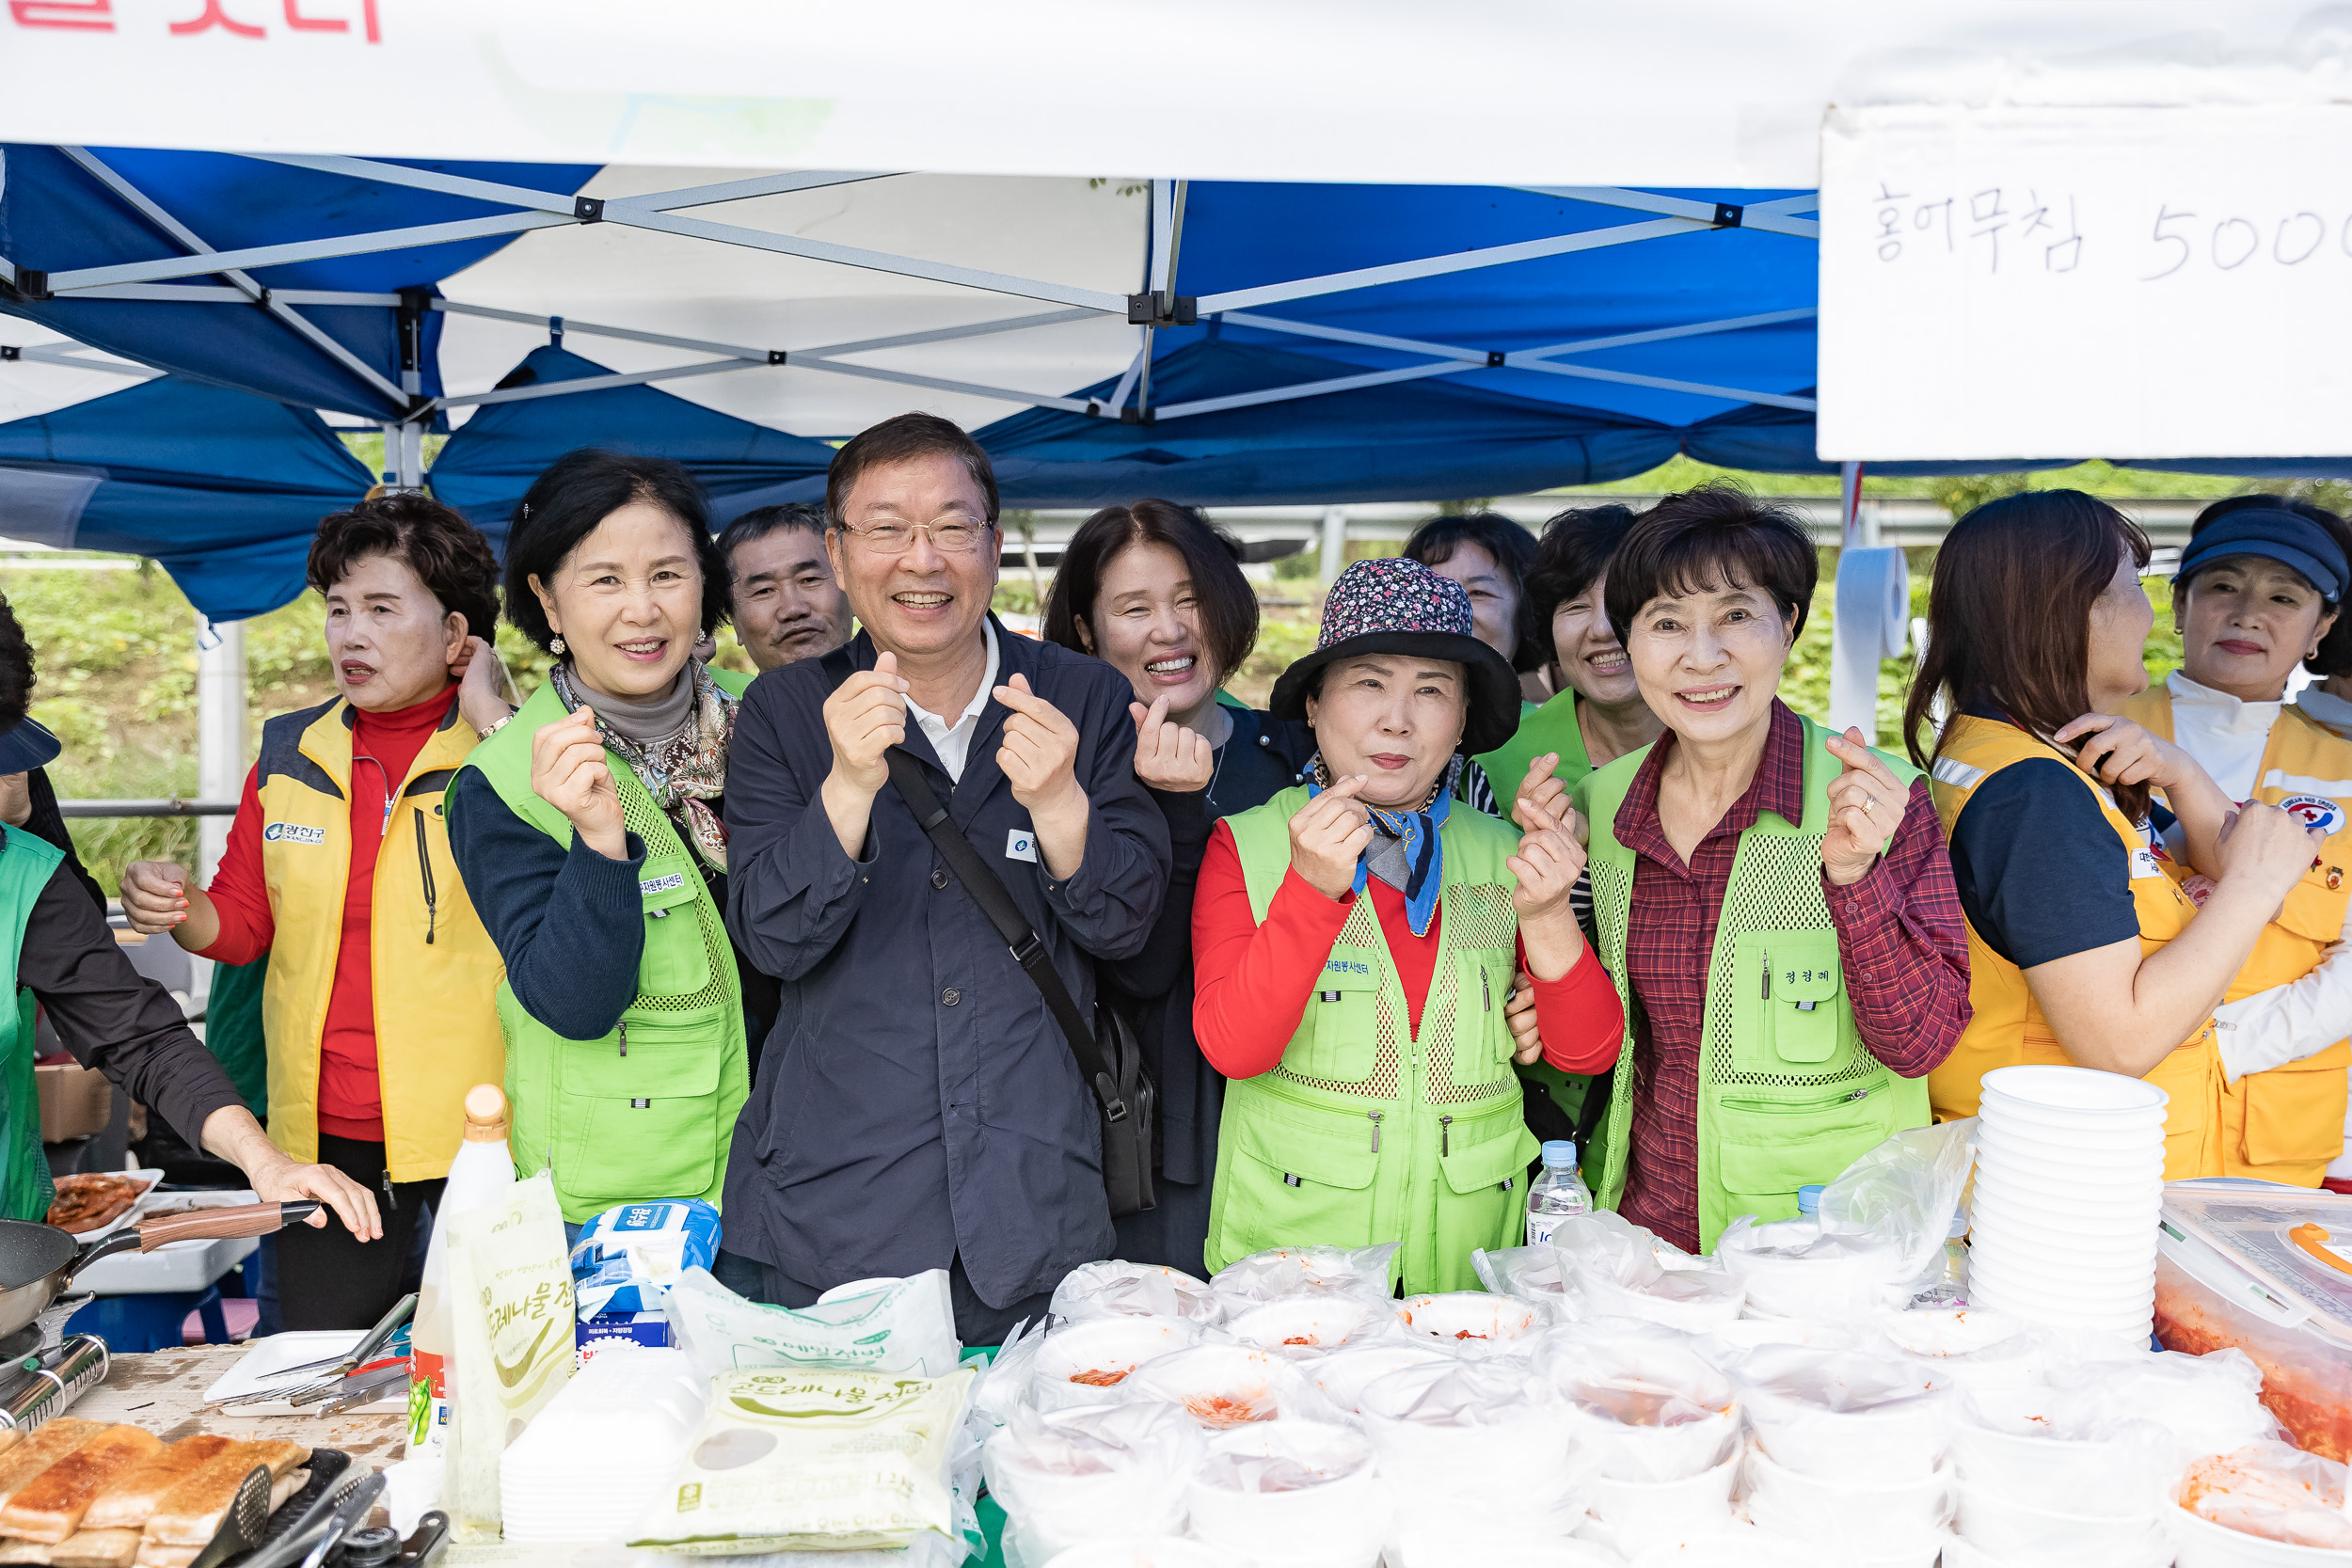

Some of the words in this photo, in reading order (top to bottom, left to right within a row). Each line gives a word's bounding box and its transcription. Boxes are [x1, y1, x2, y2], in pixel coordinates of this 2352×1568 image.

[1873, 182, 2082, 275] 홍어무침
[2138, 204, 2352, 281] 500
[285, 824, 325, 838] 광진구
[1322, 959, 1369, 975] 자원봉사센터
[486, 1282, 552, 1351] 드레나물
[728, 1382, 867, 1404] 곤드레나물
